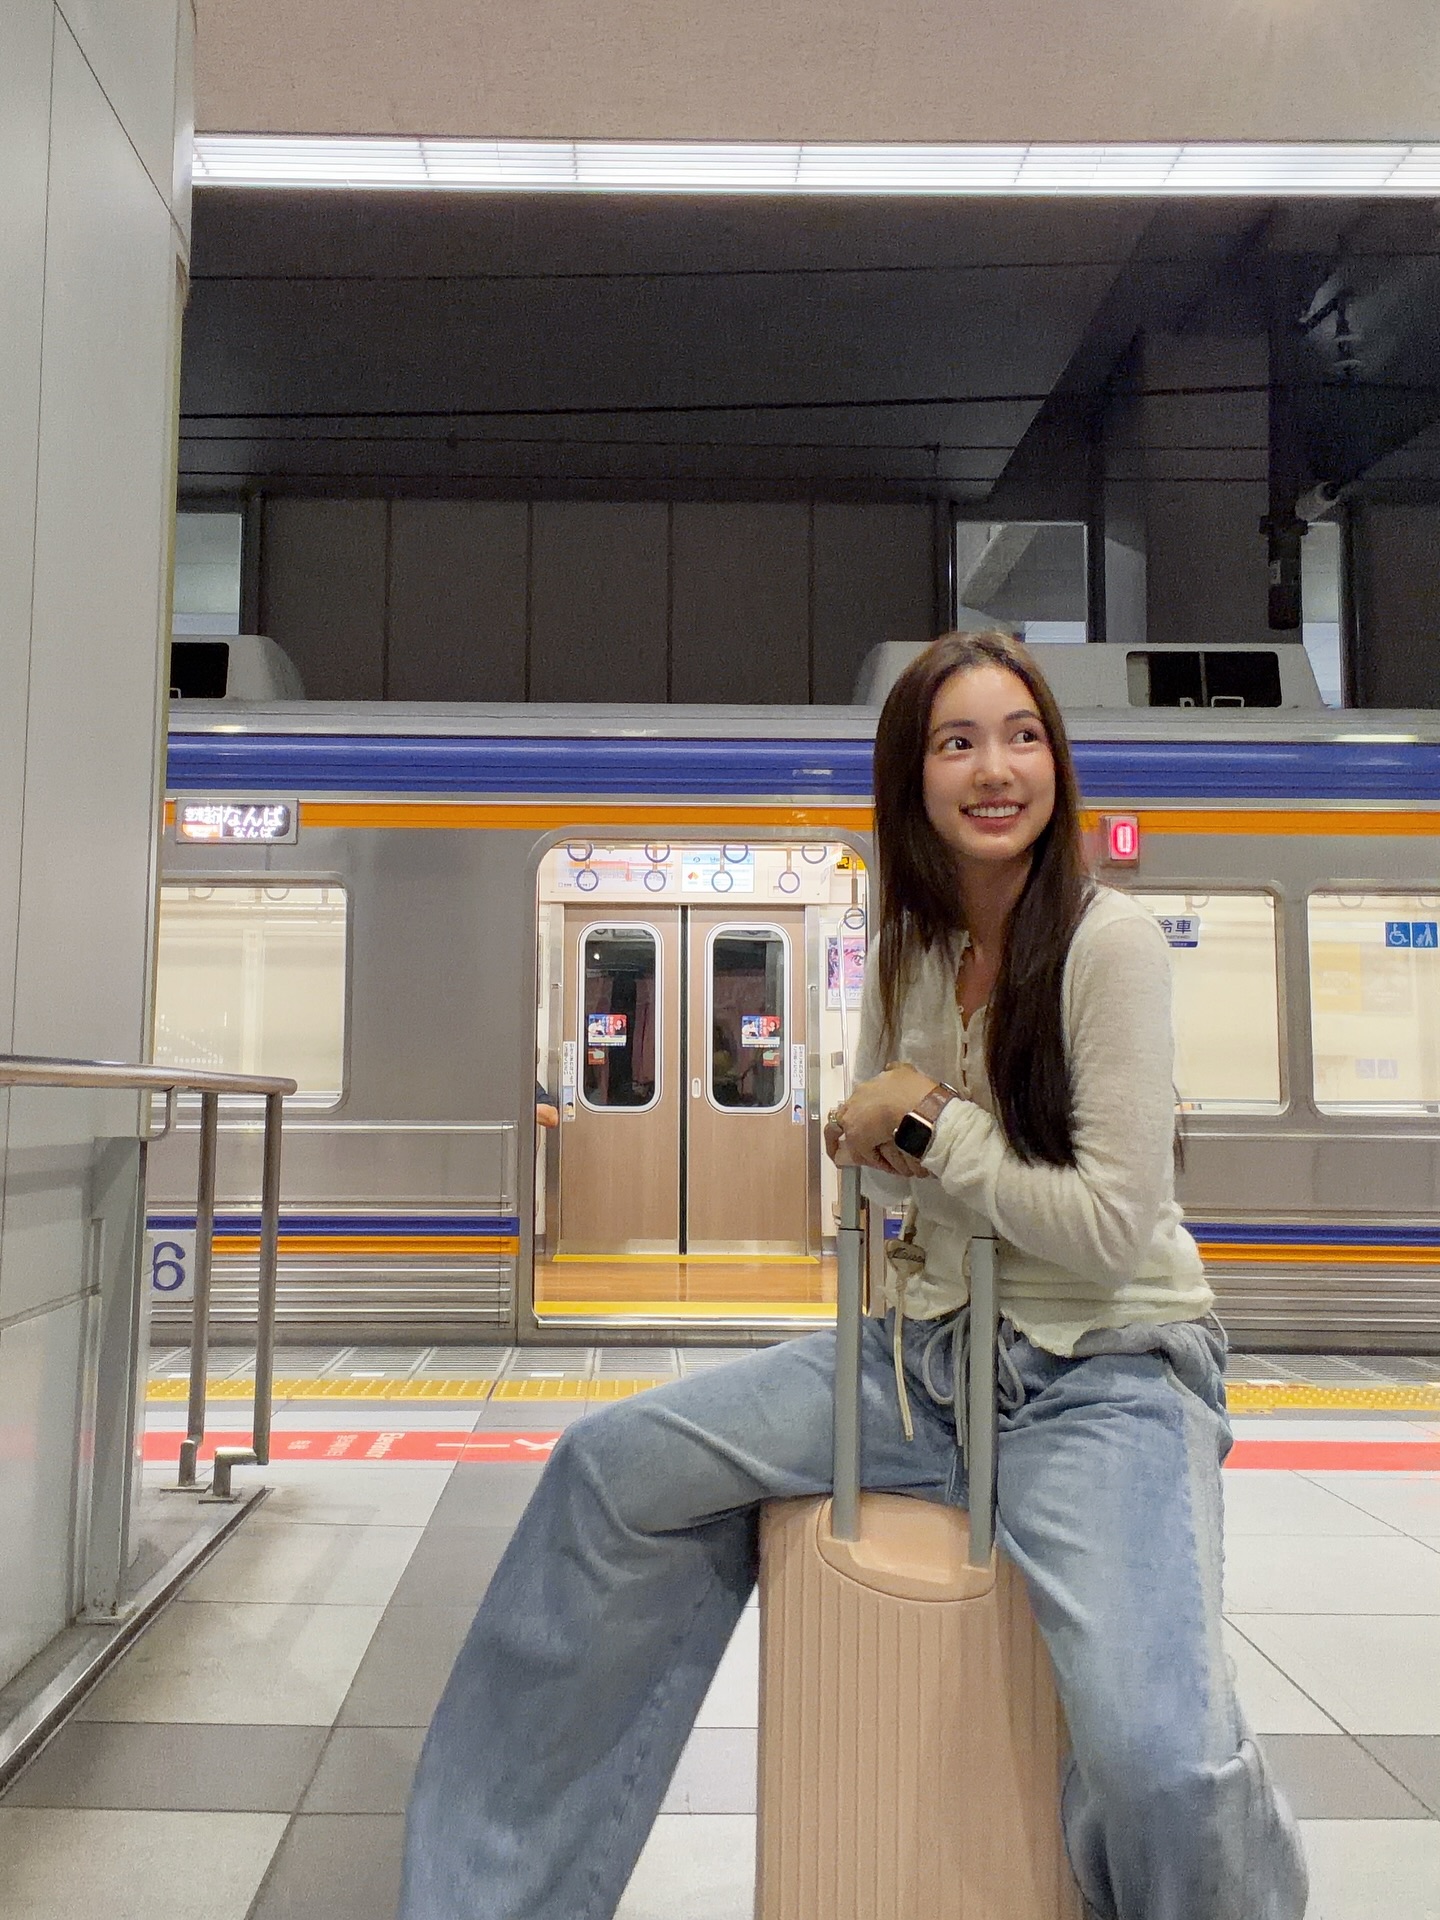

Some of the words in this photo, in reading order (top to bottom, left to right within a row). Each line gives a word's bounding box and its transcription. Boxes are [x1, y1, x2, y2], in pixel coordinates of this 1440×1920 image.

[223, 805, 283, 827] なんば
[152, 1240, 186, 1291] 6
[364, 1432, 406, 1459] Elevator
